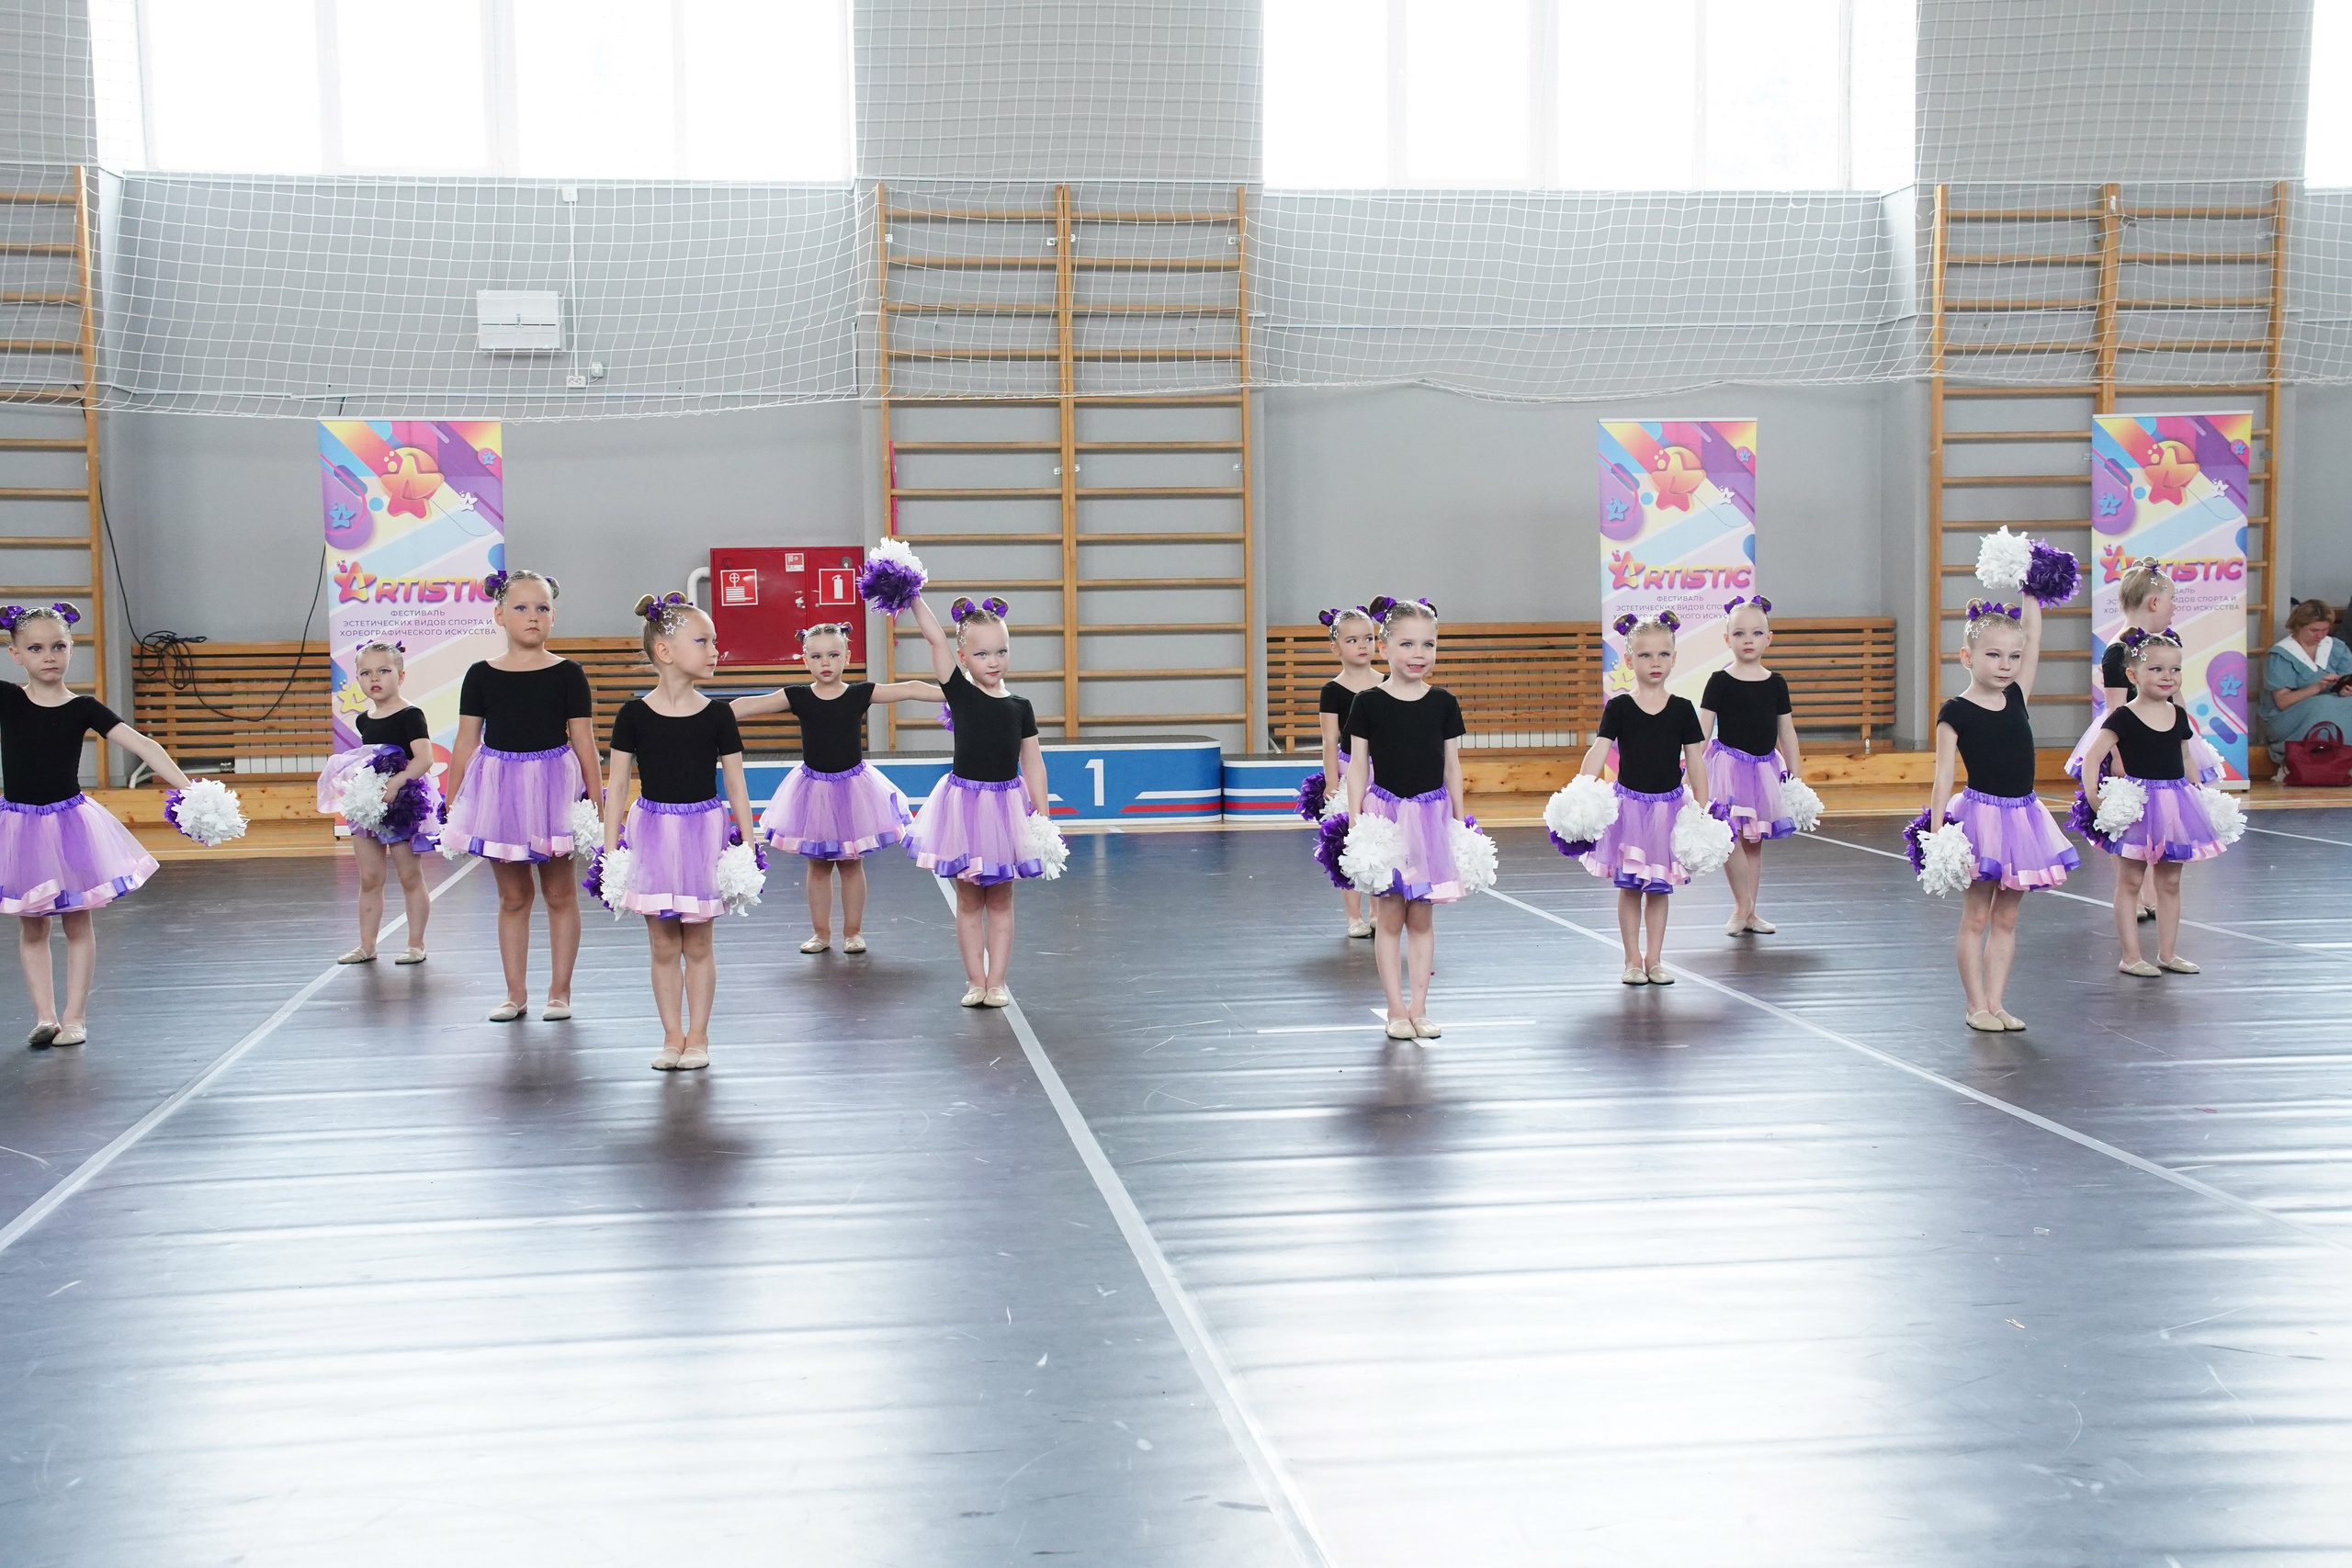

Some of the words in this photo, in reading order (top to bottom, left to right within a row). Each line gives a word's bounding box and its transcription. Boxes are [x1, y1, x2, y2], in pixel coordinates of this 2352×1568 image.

[1609, 551, 1751, 590] ARTISTIC
[2100, 546, 2244, 583] ATISTIC
[1085, 759, 1104, 806] 1
